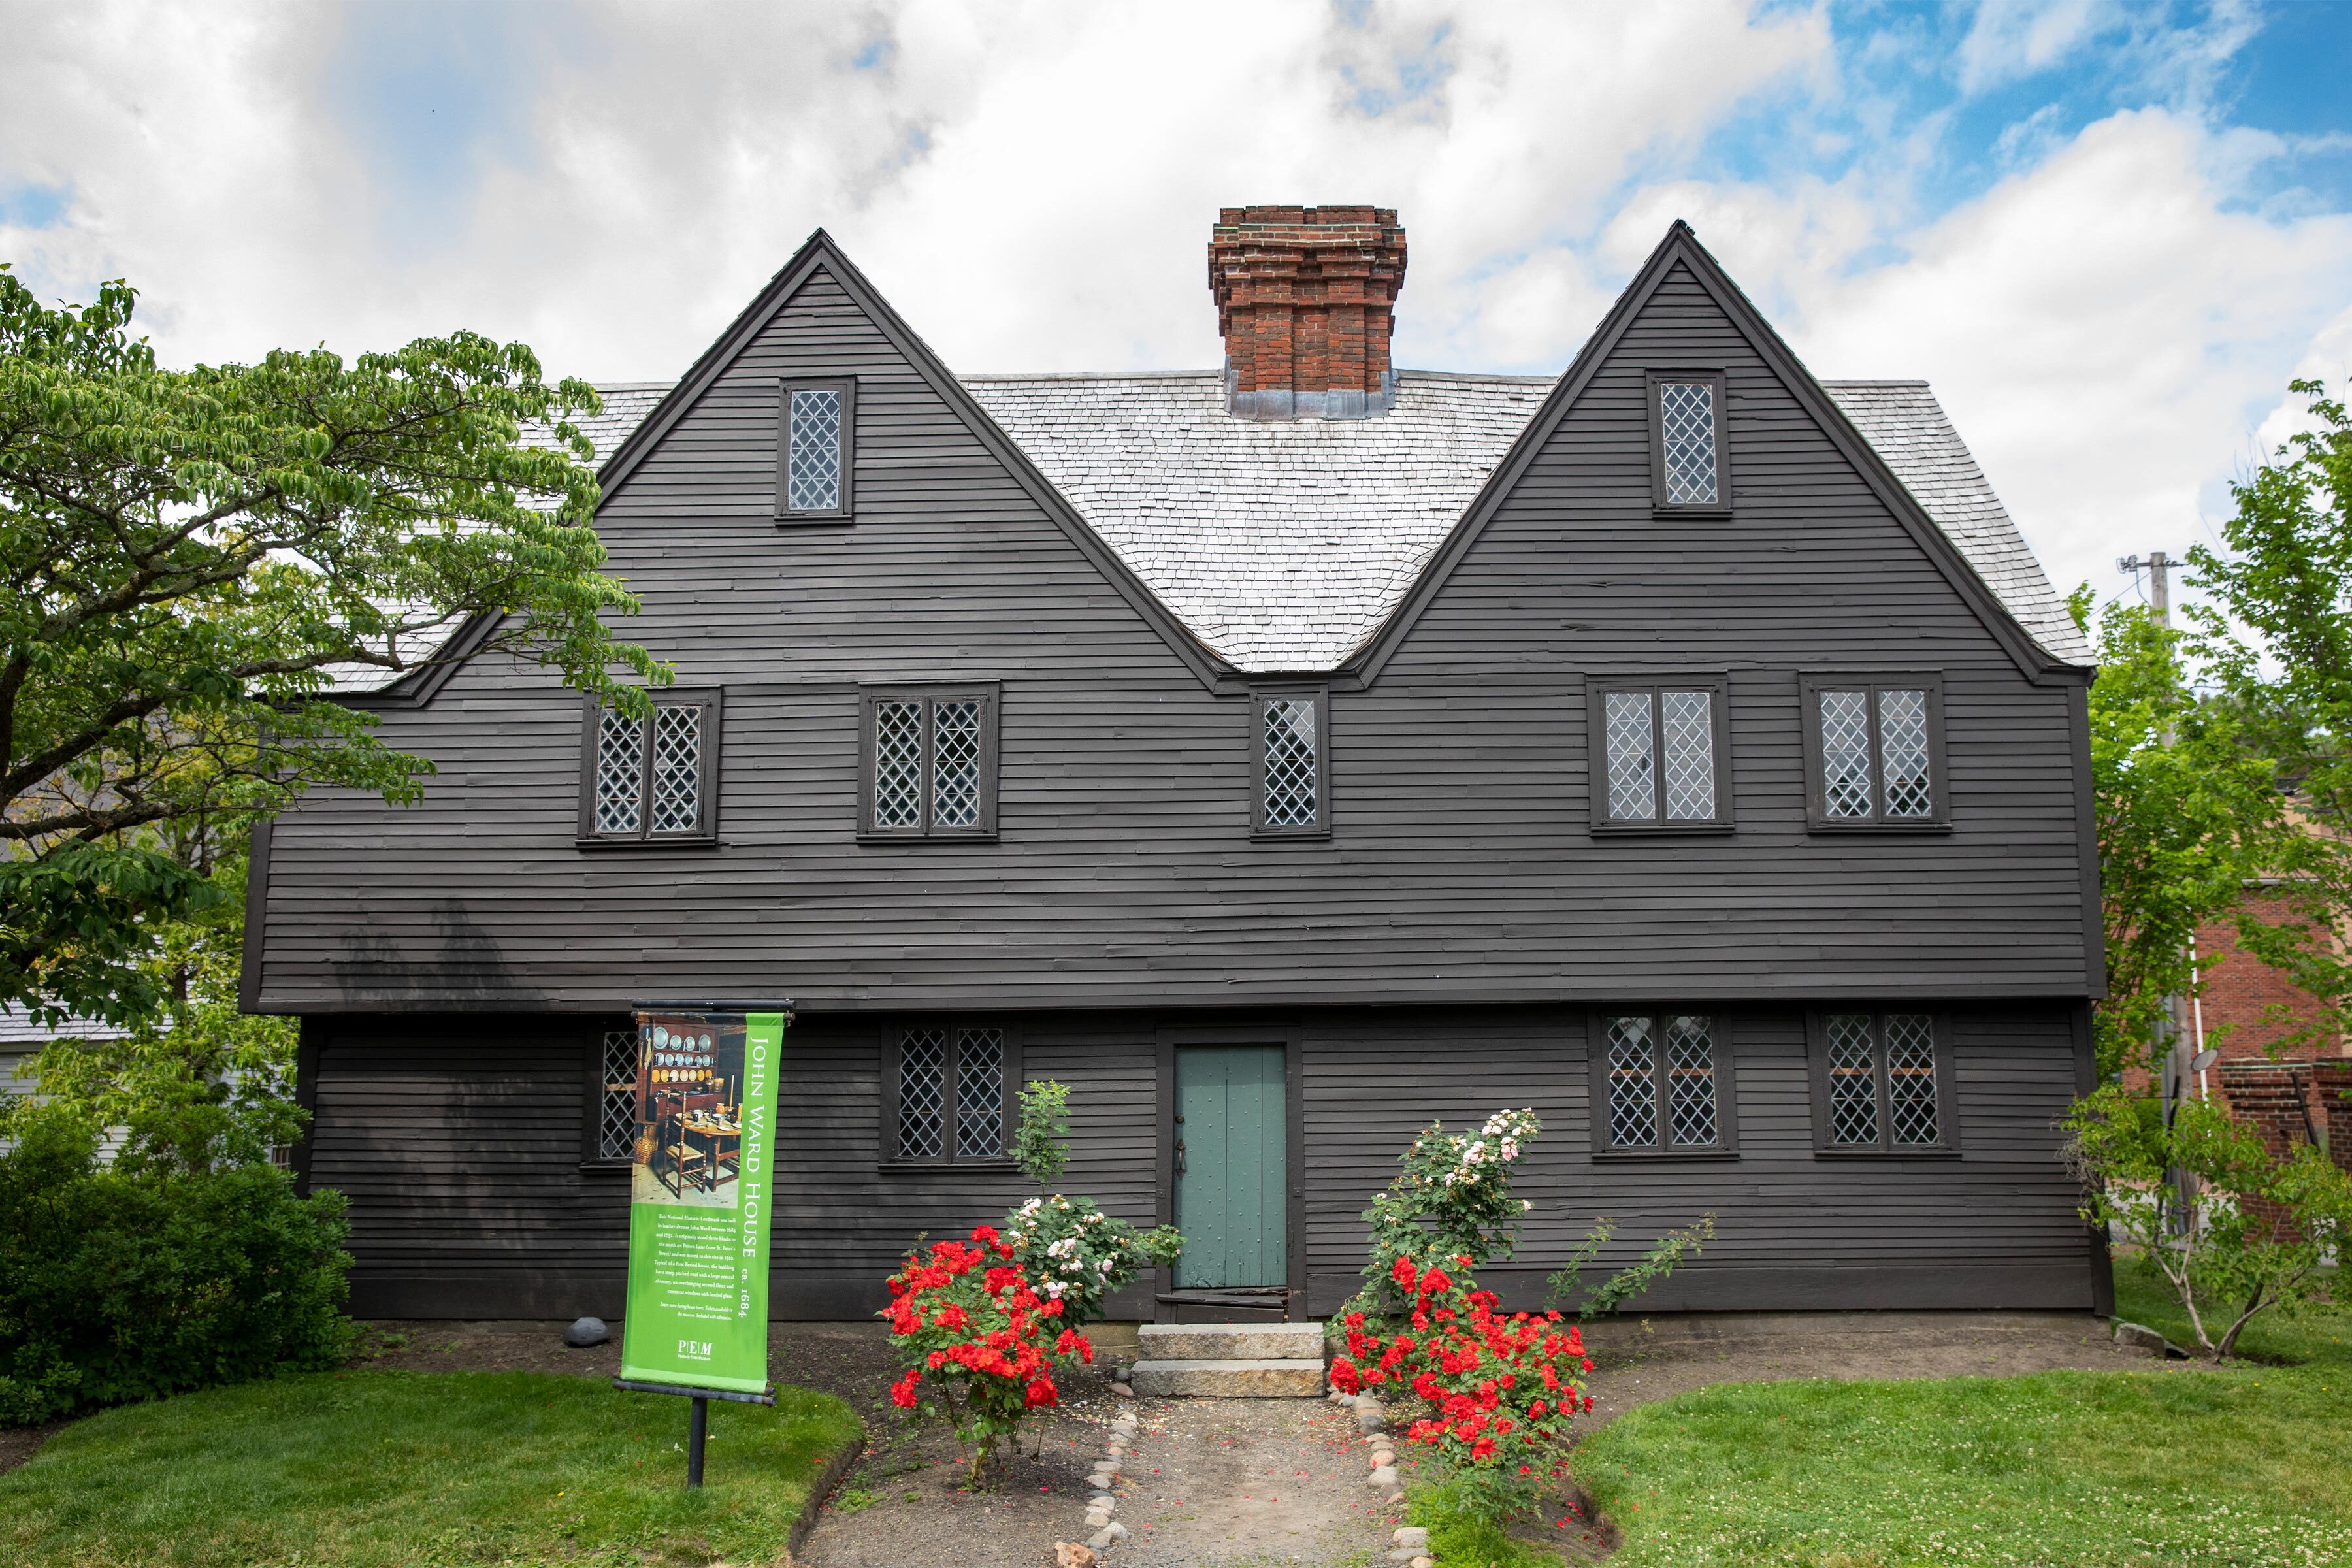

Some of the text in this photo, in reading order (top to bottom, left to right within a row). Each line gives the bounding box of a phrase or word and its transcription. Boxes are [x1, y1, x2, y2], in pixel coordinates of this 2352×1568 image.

[749, 1036, 769, 1097] JOHN
[747, 1104, 764, 1173] WARD
[743, 1182, 760, 1257] HOUSE
[738, 1289, 750, 1318] 1684
